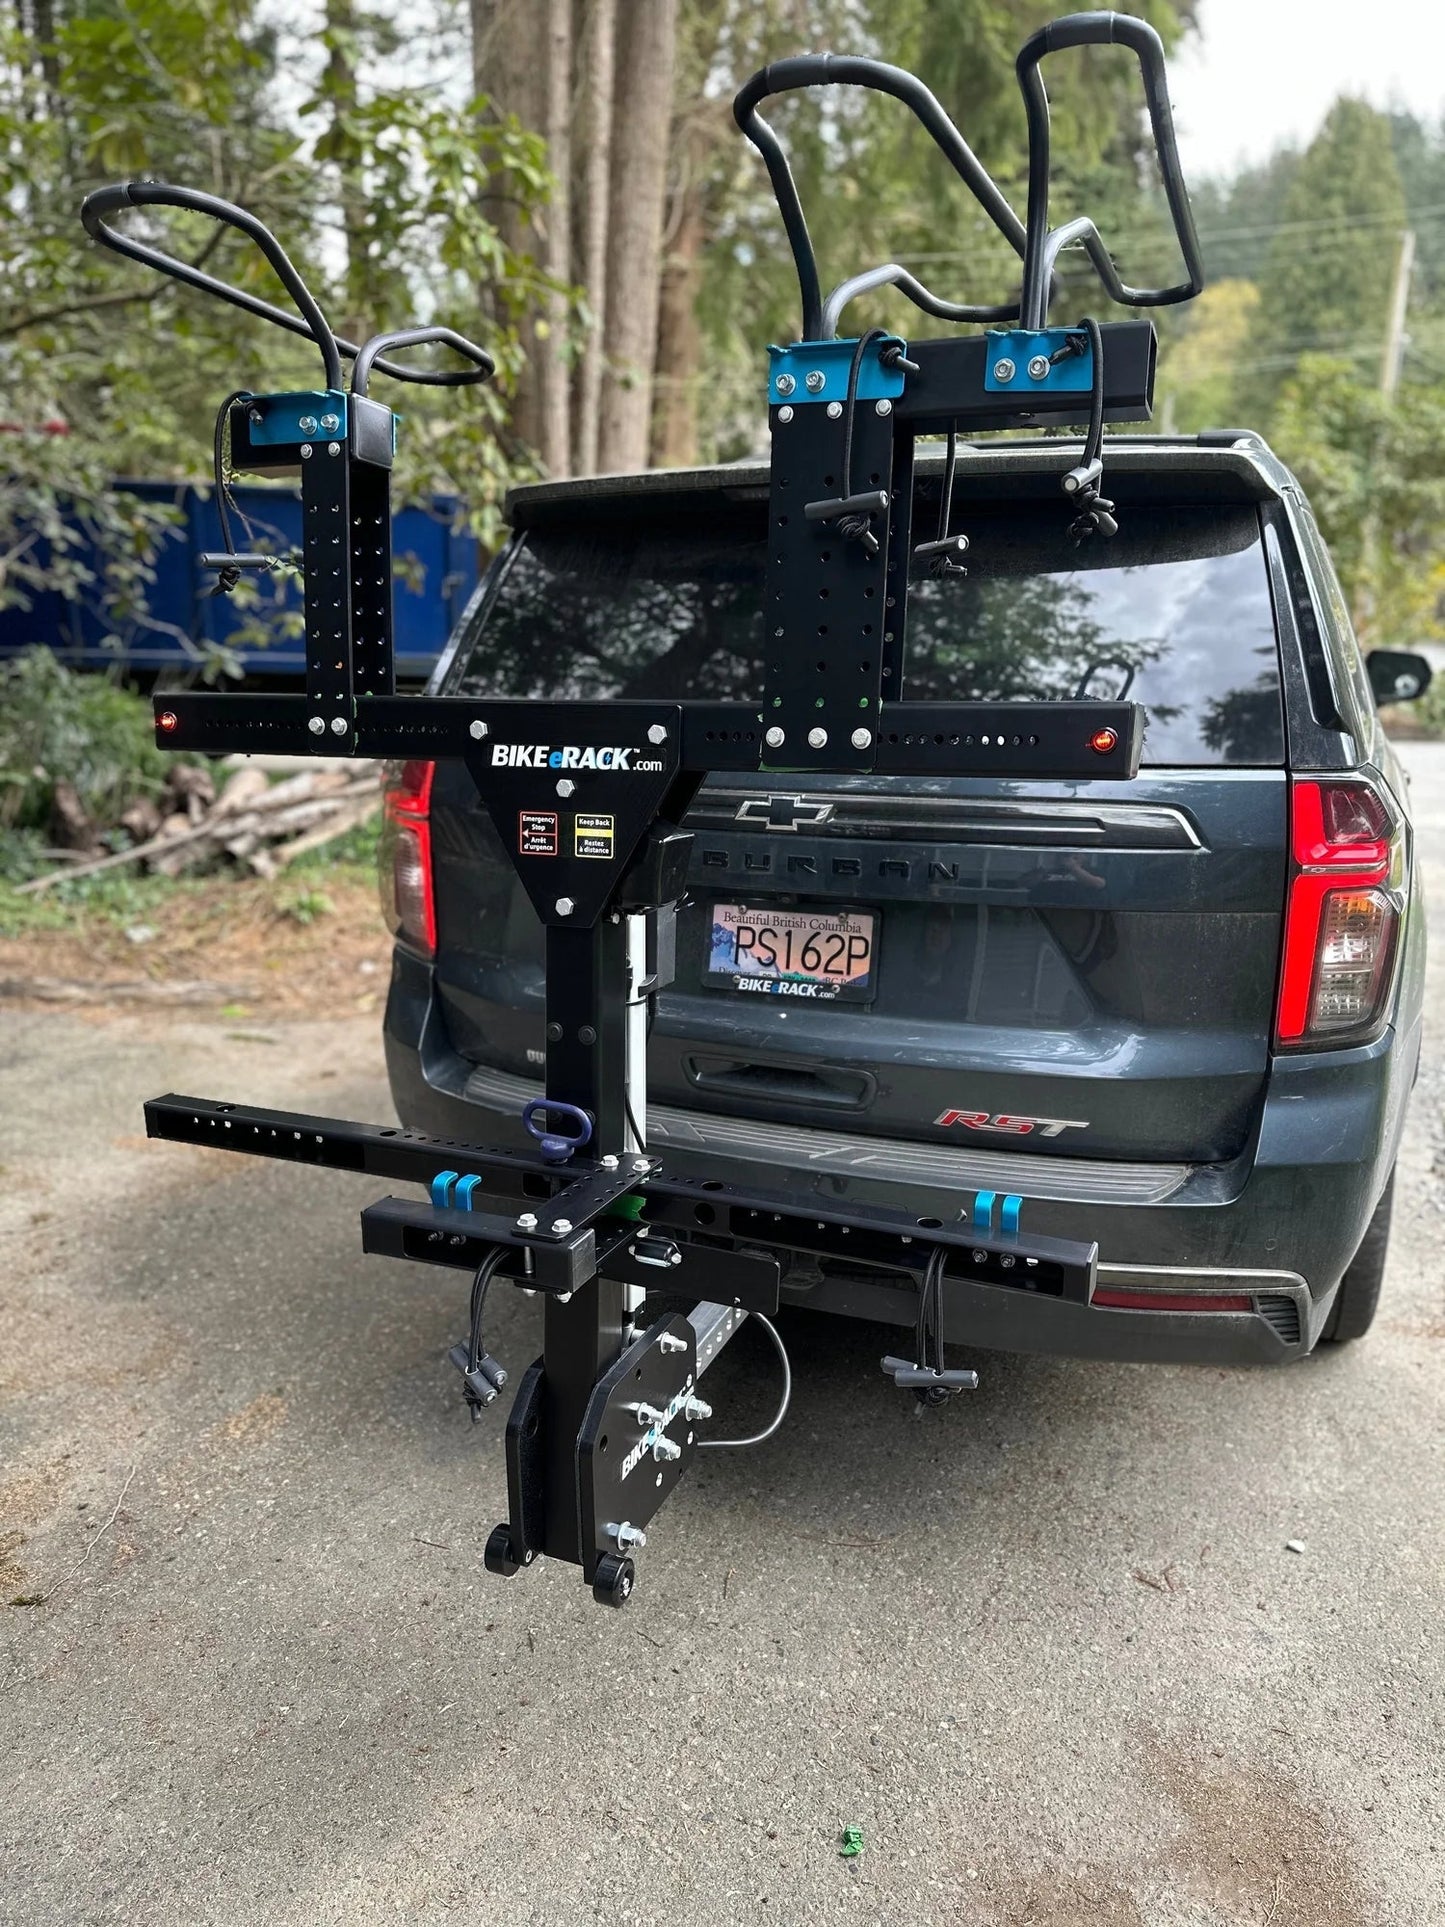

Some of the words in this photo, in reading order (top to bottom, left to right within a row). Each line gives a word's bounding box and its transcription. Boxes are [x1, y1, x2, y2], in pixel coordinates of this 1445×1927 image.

[522, 814, 555, 824] Emergency
[579, 818, 595, 826] Keep
[531, 823, 546, 831] Stop
[530, 836, 546, 844] Arrêt
[523, 842, 553, 851] d'urgence
[584, 846, 609, 854] distance
[703, 850, 960, 881] BURBAN
[723, 911, 771, 925] Beautiful
[772, 915, 807, 930] British
[809, 918, 862, 934] Columbia
[733, 925, 870, 976] PS162P
[932, 1108, 1091, 1137] RST
